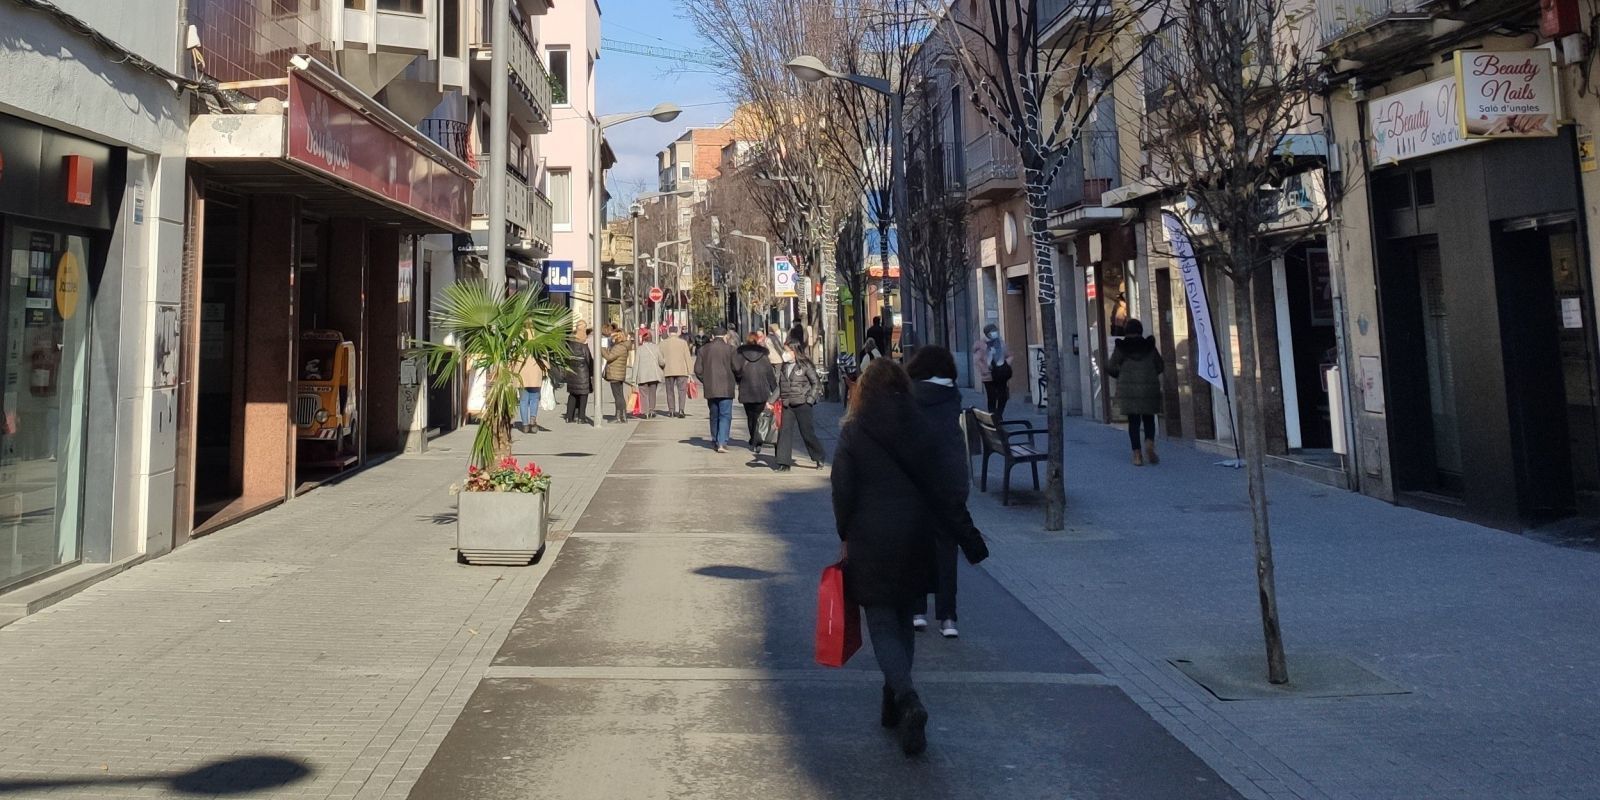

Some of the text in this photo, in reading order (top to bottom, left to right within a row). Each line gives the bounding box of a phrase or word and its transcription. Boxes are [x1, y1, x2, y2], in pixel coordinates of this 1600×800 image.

[1473, 54, 1540, 82] Beauty
[1481, 80, 1536, 103] Nails
[1500, 103, 1540, 113] d'ungles
[1387, 101, 1430, 142] Beauty
